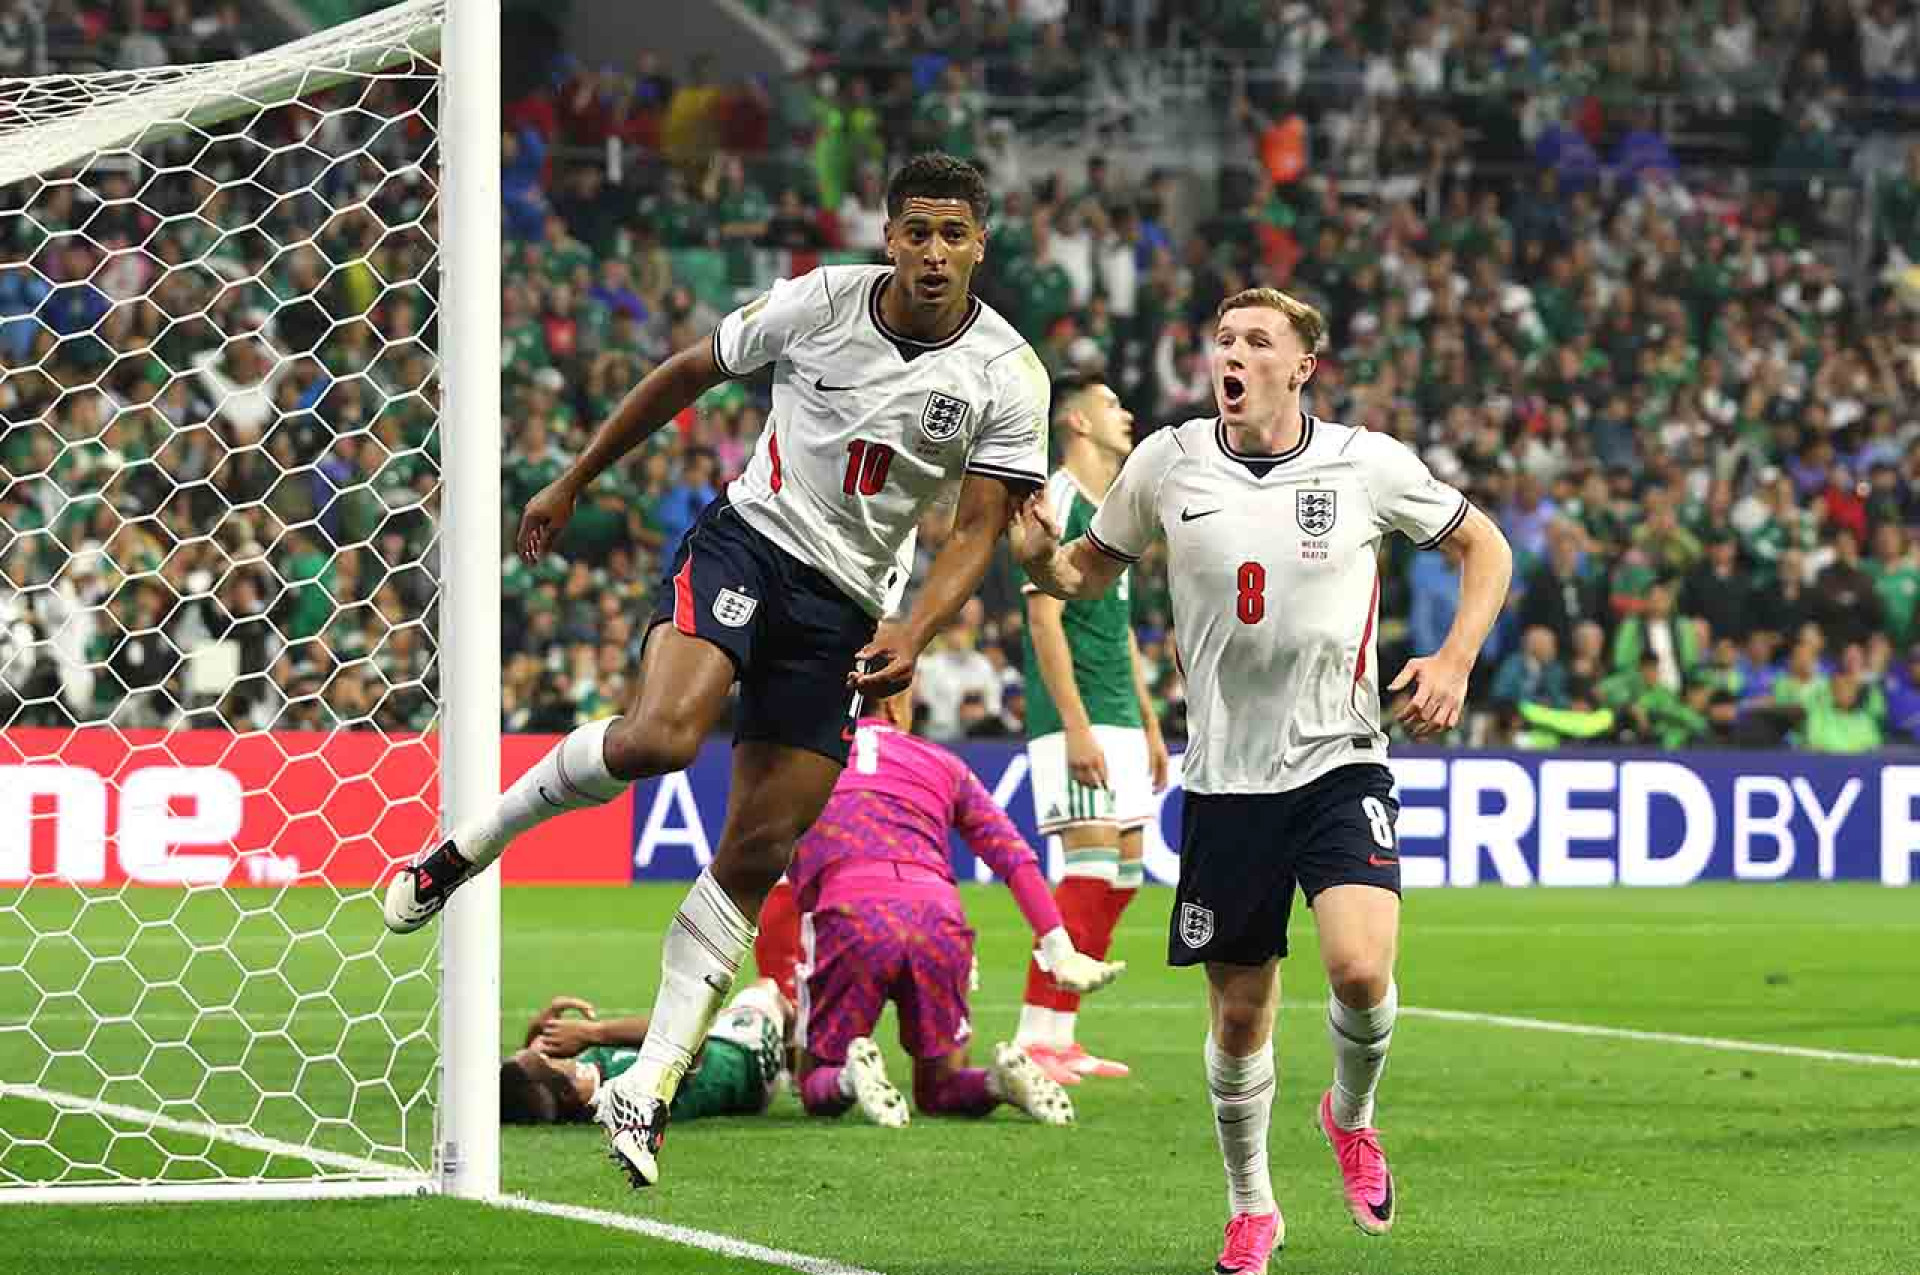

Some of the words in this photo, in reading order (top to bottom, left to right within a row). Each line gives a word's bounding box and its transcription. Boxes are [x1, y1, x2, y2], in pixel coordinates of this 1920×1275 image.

[843, 438, 896, 495] 10
[1236, 561, 1266, 625] 8
[1361, 796, 1393, 849] 8
[1734, 775, 1863, 880] BY
